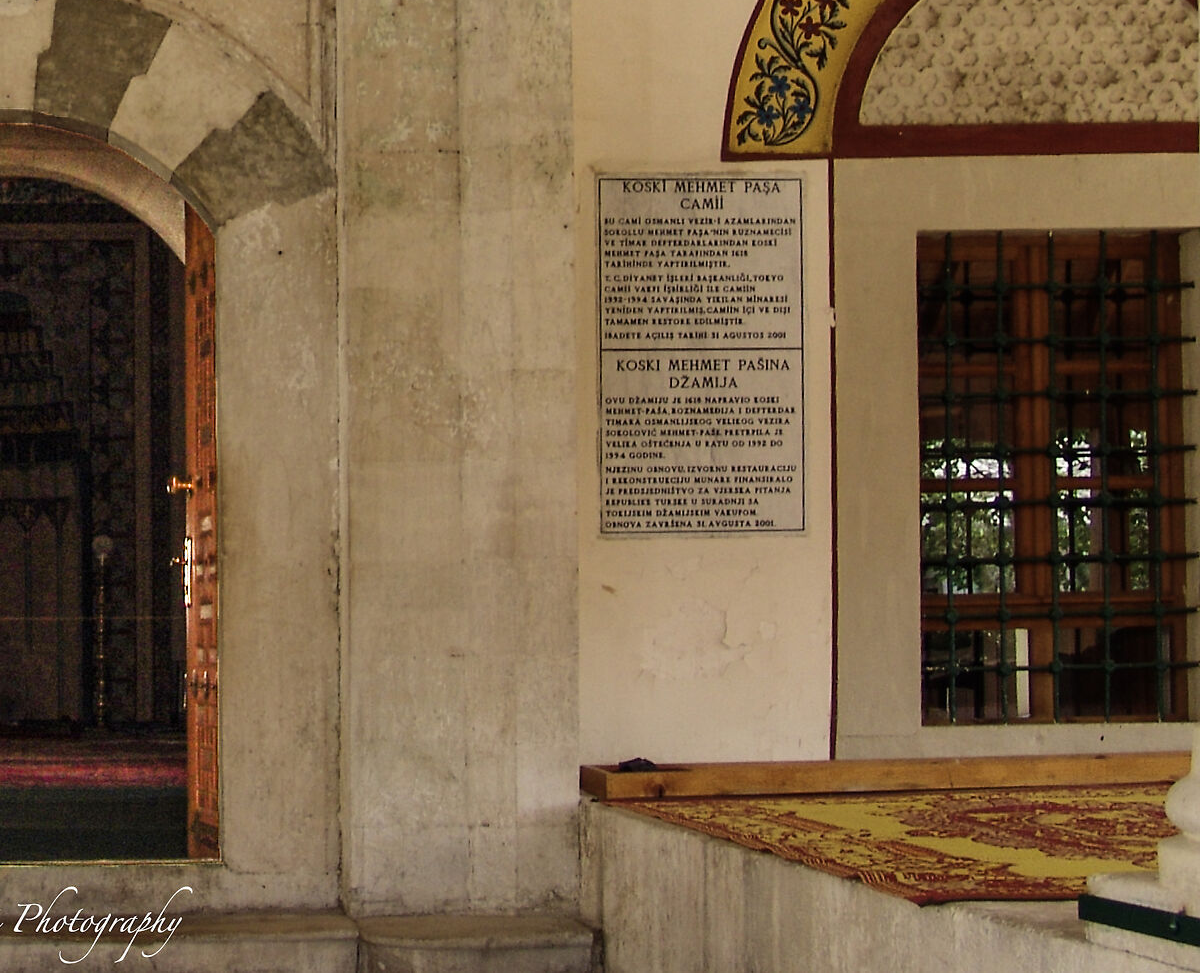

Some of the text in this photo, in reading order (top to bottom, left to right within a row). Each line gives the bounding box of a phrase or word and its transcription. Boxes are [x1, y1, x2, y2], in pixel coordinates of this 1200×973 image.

[623, 180, 781, 196] KOSKİ MEHMET PAŞA
[680, 195, 724, 210] CAMİİ
[616, 356, 790, 372] KOSKI MEHMET PAŠINA
[669, 375, 738, 389] DŽAMIJA
